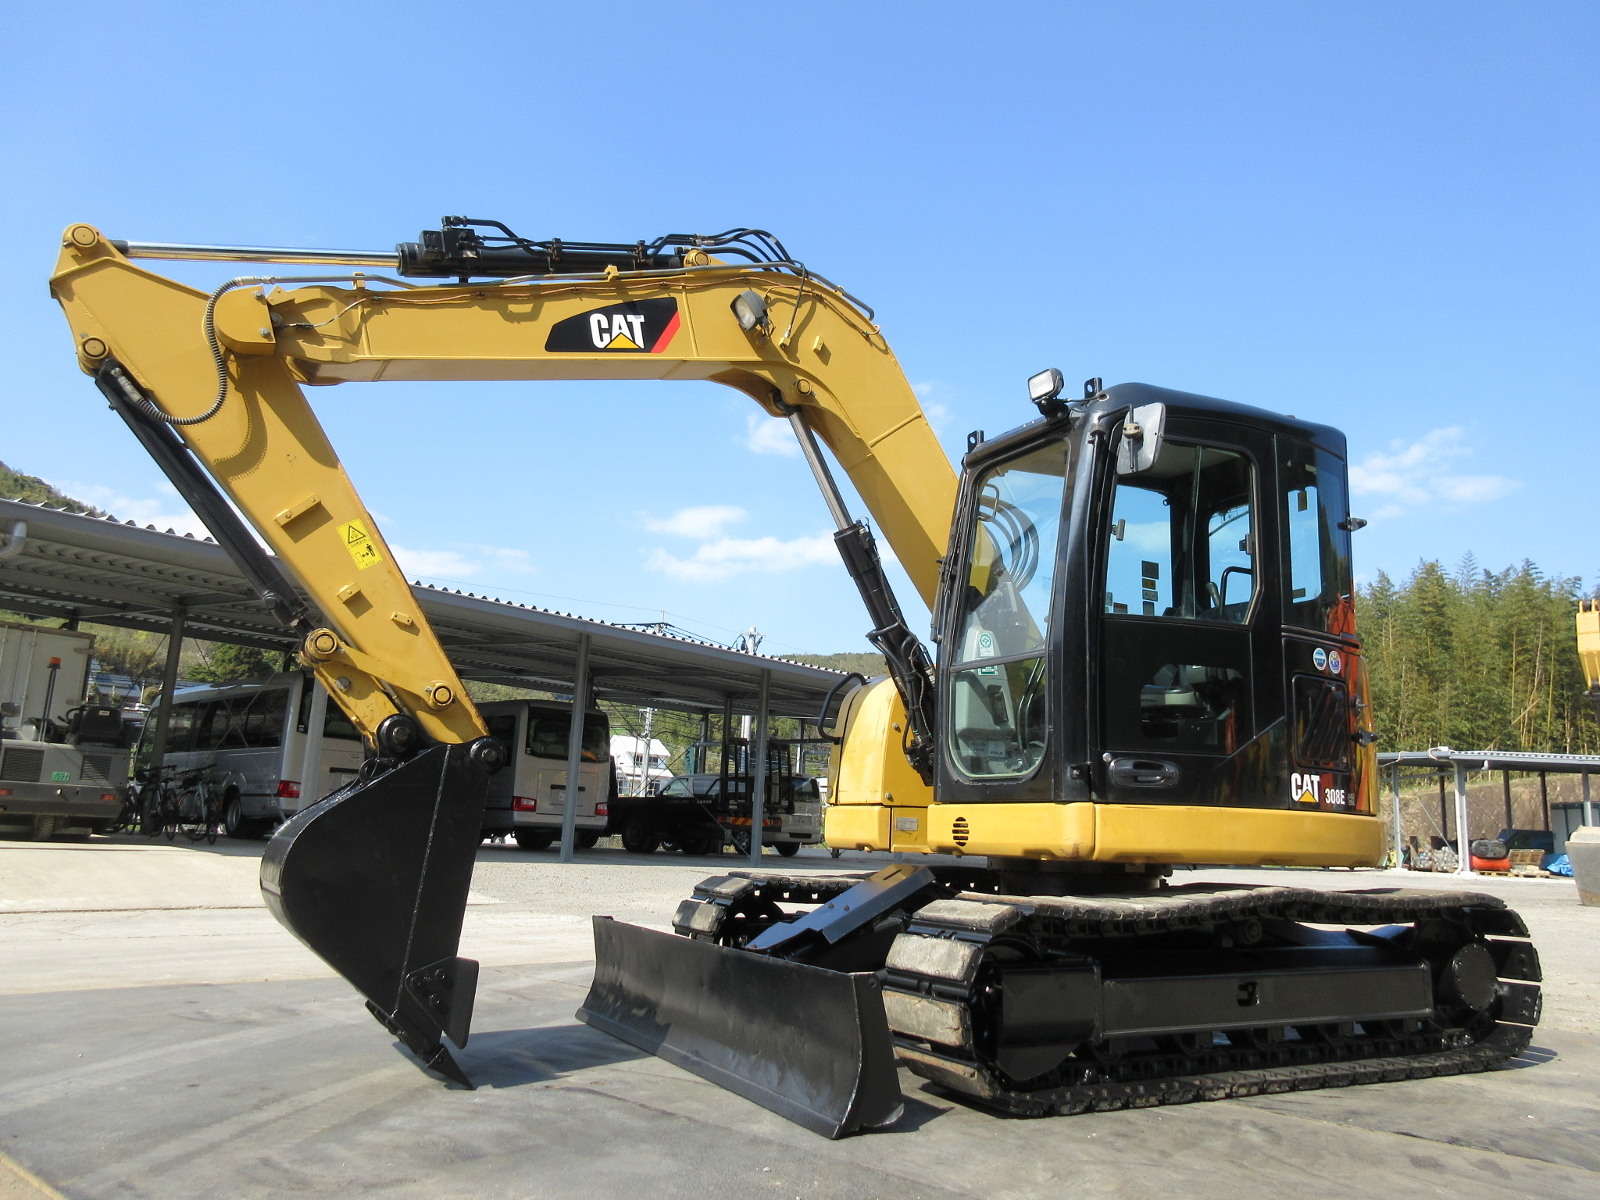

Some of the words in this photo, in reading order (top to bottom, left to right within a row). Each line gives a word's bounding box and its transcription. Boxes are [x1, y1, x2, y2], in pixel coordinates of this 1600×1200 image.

[589, 313, 645, 349] CAT
[1291, 773, 1320, 802] CAT
[1325, 788, 1345, 804] 308E
